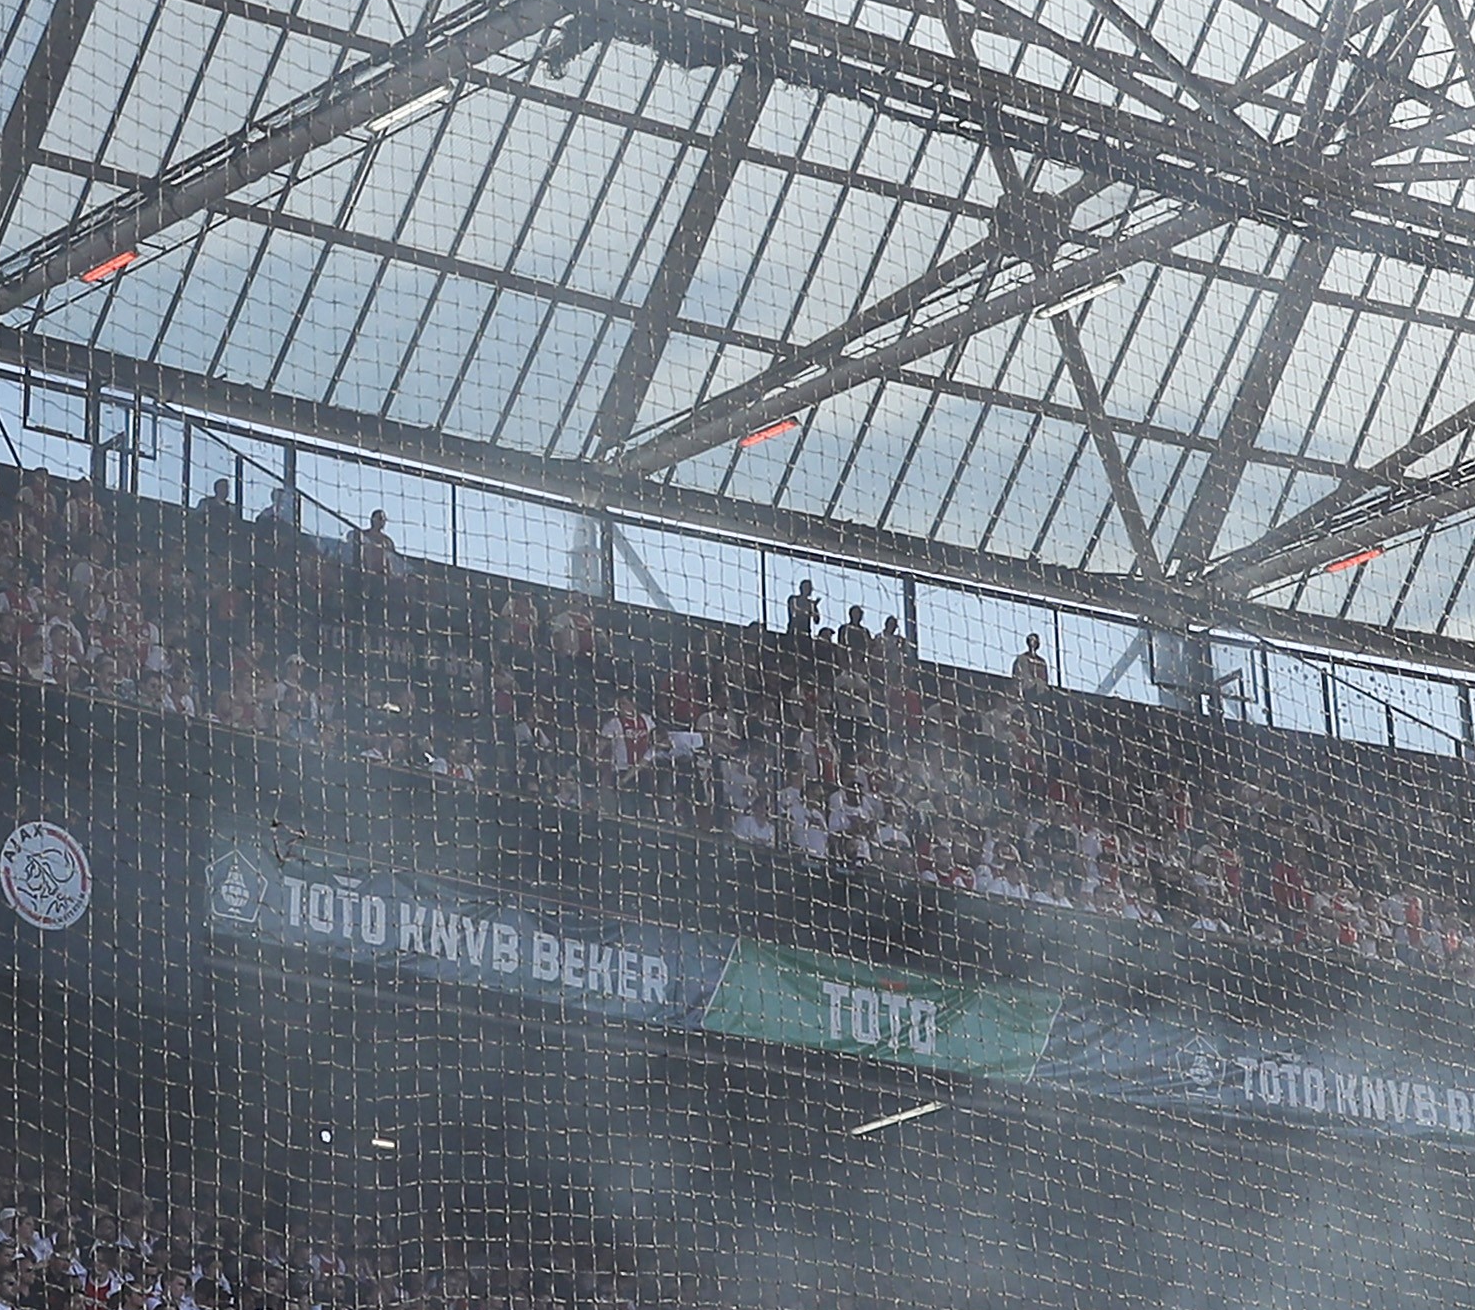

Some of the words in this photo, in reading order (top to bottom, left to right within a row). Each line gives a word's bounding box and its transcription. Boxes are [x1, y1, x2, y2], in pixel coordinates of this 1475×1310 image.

[3, 823, 44, 863] AJAX
[283, 874, 386, 946] TOTO
[399, 902, 519, 974] KNVB
[531, 930, 669, 1005] BEKER
[822, 980, 938, 1054] TOTO
[1236, 1052, 1327, 1113] TOTO
[1335, 1072, 1438, 1127] KNVB
